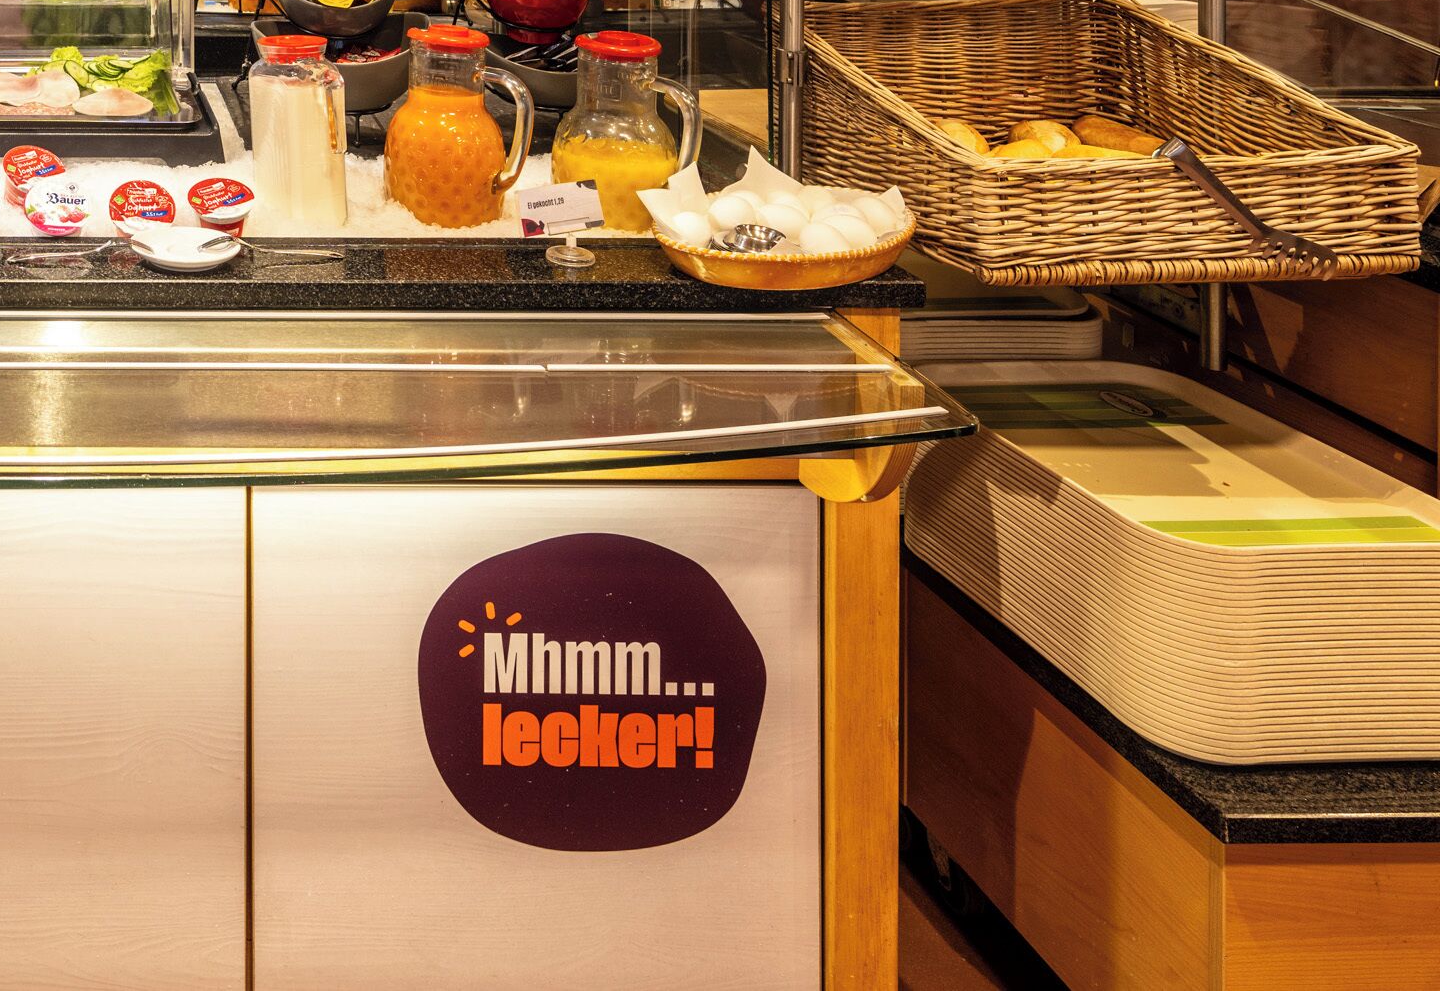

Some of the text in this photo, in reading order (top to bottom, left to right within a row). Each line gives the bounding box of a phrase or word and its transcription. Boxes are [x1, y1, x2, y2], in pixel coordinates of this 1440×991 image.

[18, 163, 45, 176] Joghurt
[46, 192, 86, 207] Bauer
[203, 193, 233, 207] Joghurt
[533, 198, 554, 209] gekocht
[123, 202, 157, 212] Joghurt
[483, 632, 715, 697] Mhmm...
[482, 702, 715, 769] lecker!
